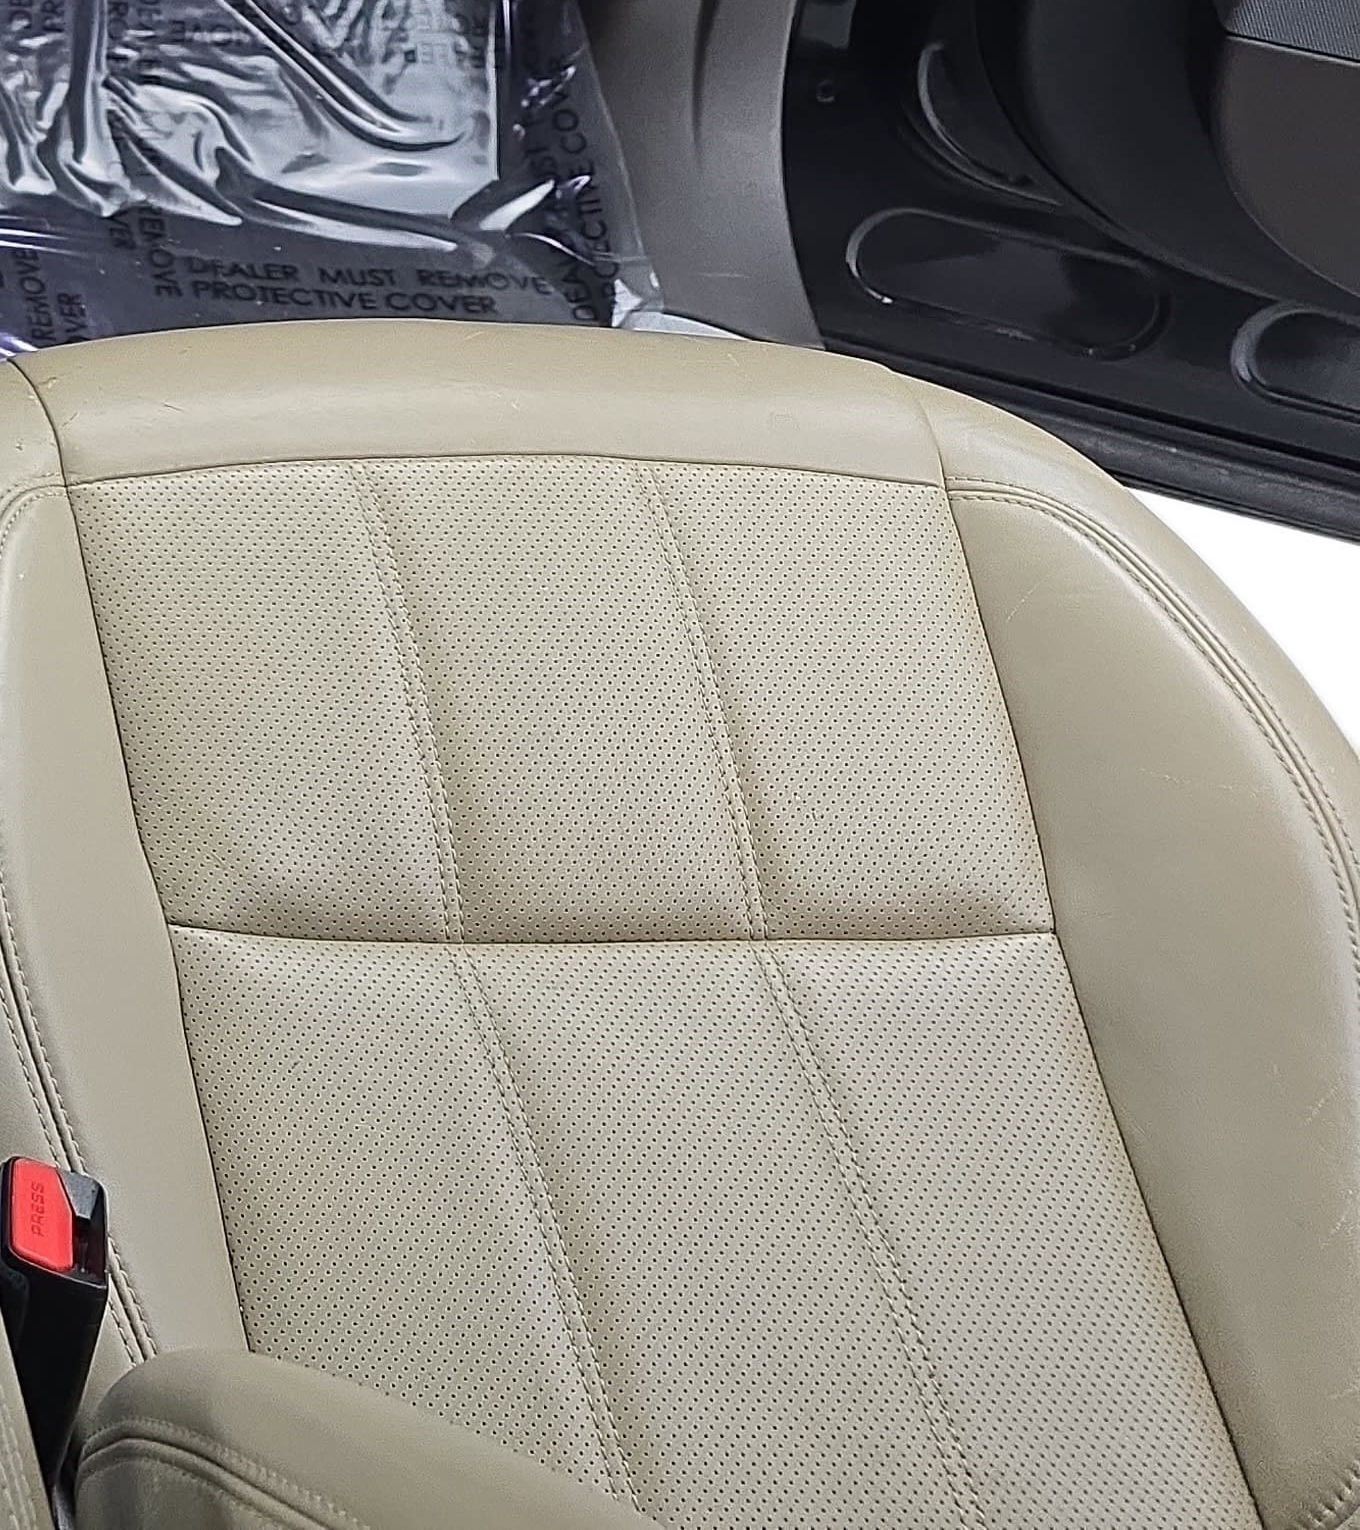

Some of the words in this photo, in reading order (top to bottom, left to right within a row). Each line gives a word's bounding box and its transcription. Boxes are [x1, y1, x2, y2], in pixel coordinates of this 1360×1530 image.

[189, 256, 301, 282] DEALER
[319, 265, 396, 287] MUST
[418, 268, 553, 297] REMOVE
[192, 279, 377, 311] PROTECTIVE
[384, 290, 499, 315] COVER
[31, 1180, 45, 1238] PRESS
